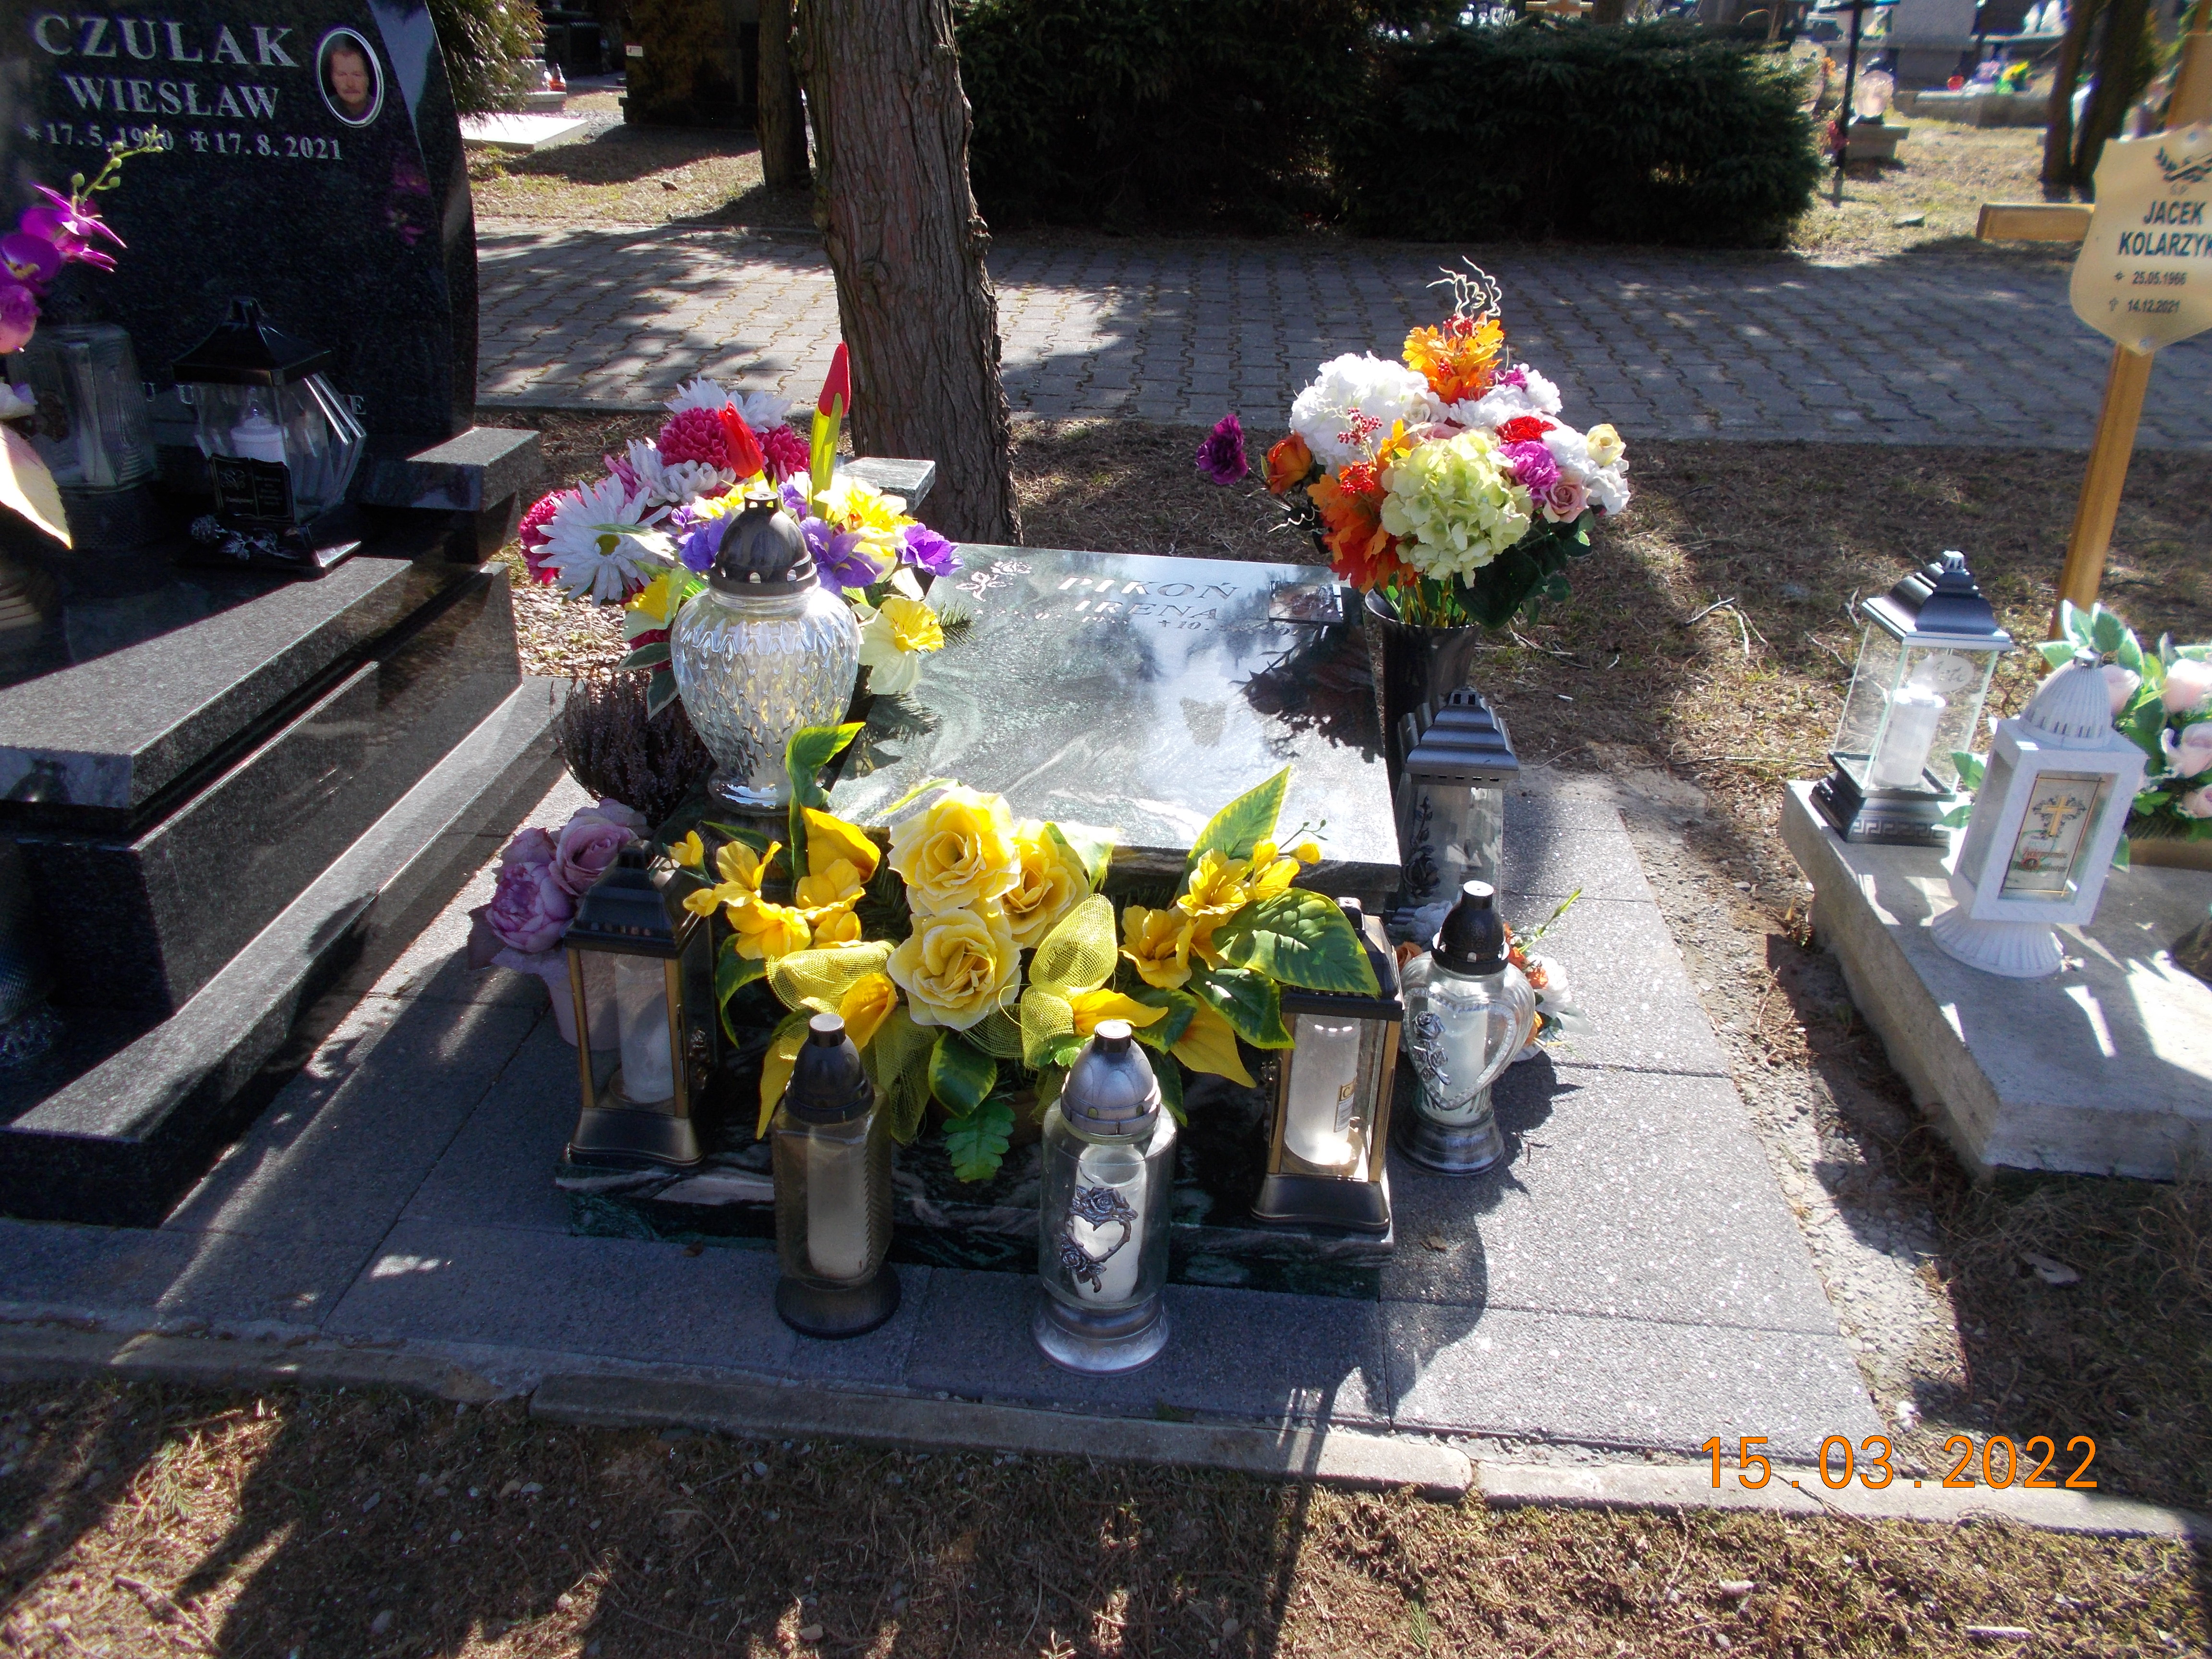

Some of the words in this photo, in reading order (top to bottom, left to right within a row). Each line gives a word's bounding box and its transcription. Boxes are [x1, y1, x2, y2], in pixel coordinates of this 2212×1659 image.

[34, 14, 300, 68] CZULAK
[63, 74, 280, 120] WIESŁAW
[215, 132, 343, 160] 17.8.2021
[2143, 200, 2207, 225] JACEK
[2127, 298, 2181, 313] 14.12.2021
[1058, 576, 1242, 600] PIKOŃ
[1074, 600, 1218, 620] IRENA
